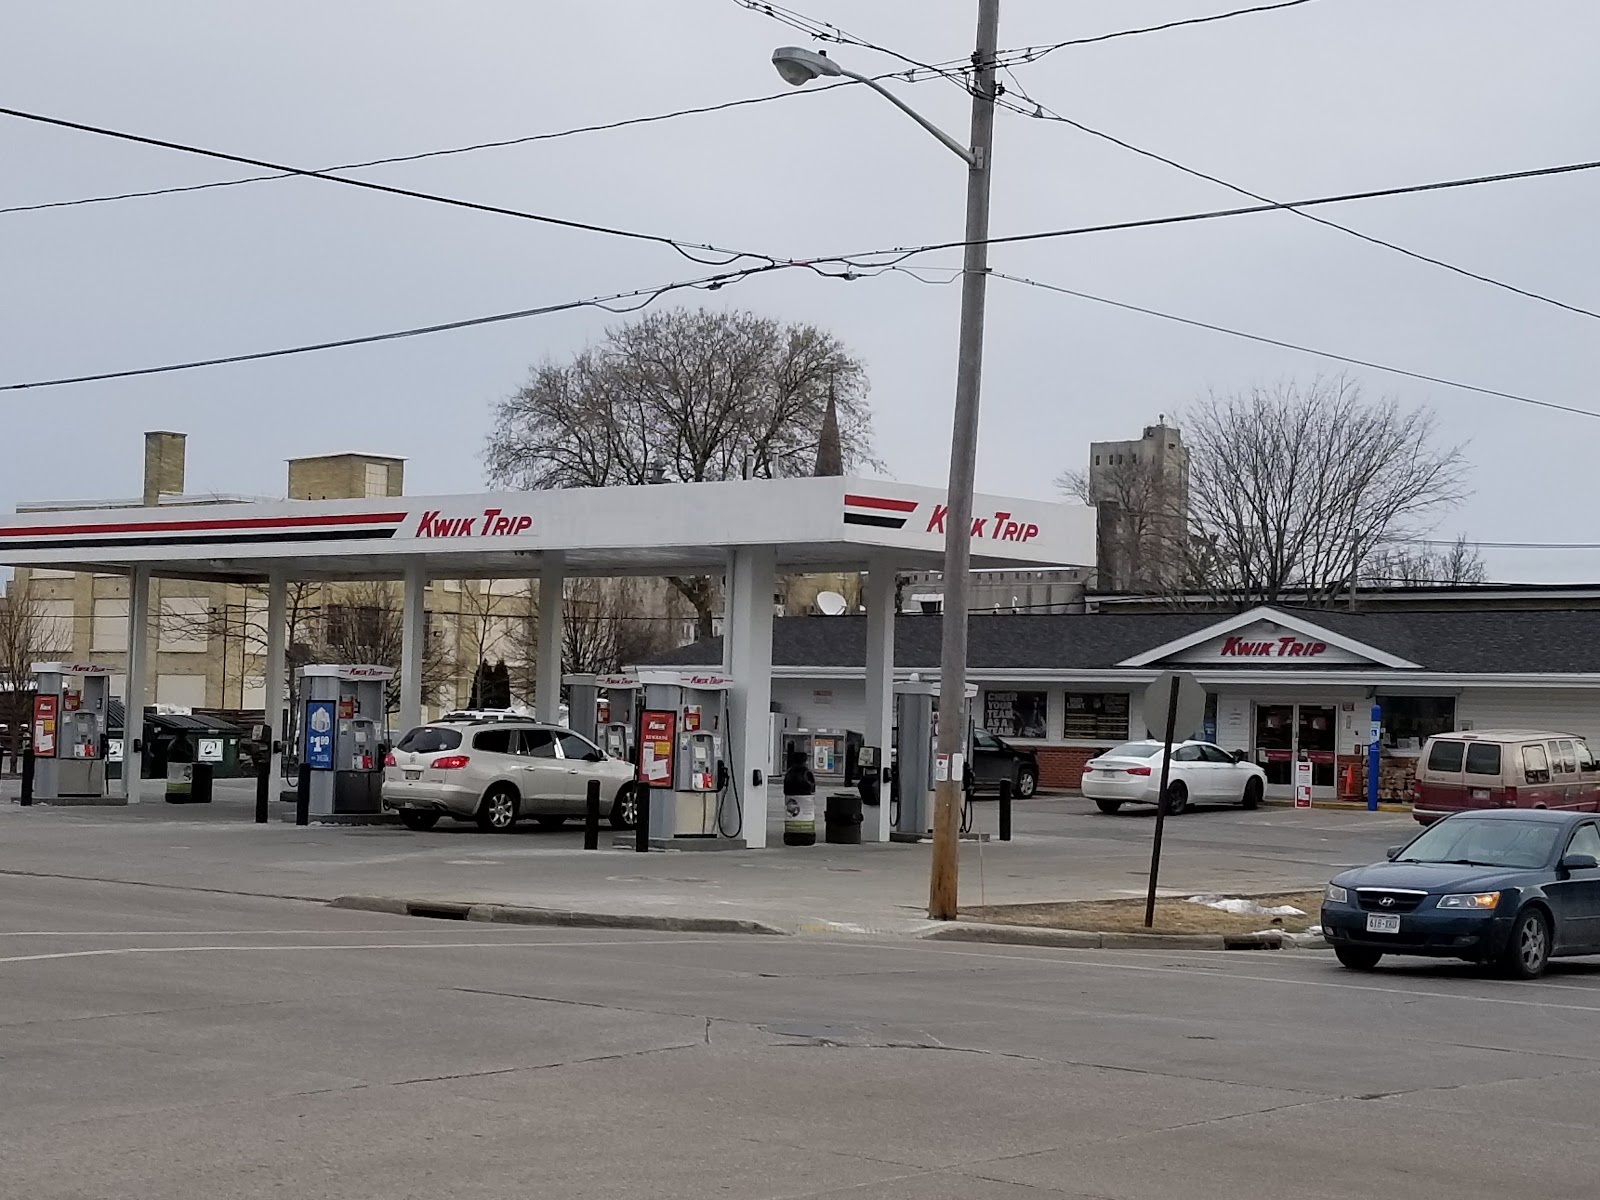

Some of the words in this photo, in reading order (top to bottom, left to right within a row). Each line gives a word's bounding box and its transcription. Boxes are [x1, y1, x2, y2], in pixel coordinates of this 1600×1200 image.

[415, 511, 477, 537] KWIK
[481, 508, 532, 536] TRIP
[926, 504, 988, 538] KK
[991, 511, 1039, 542] TRIP
[1221, 637, 1274, 656] KWIK
[1278, 637, 1327, 656] TRIP
